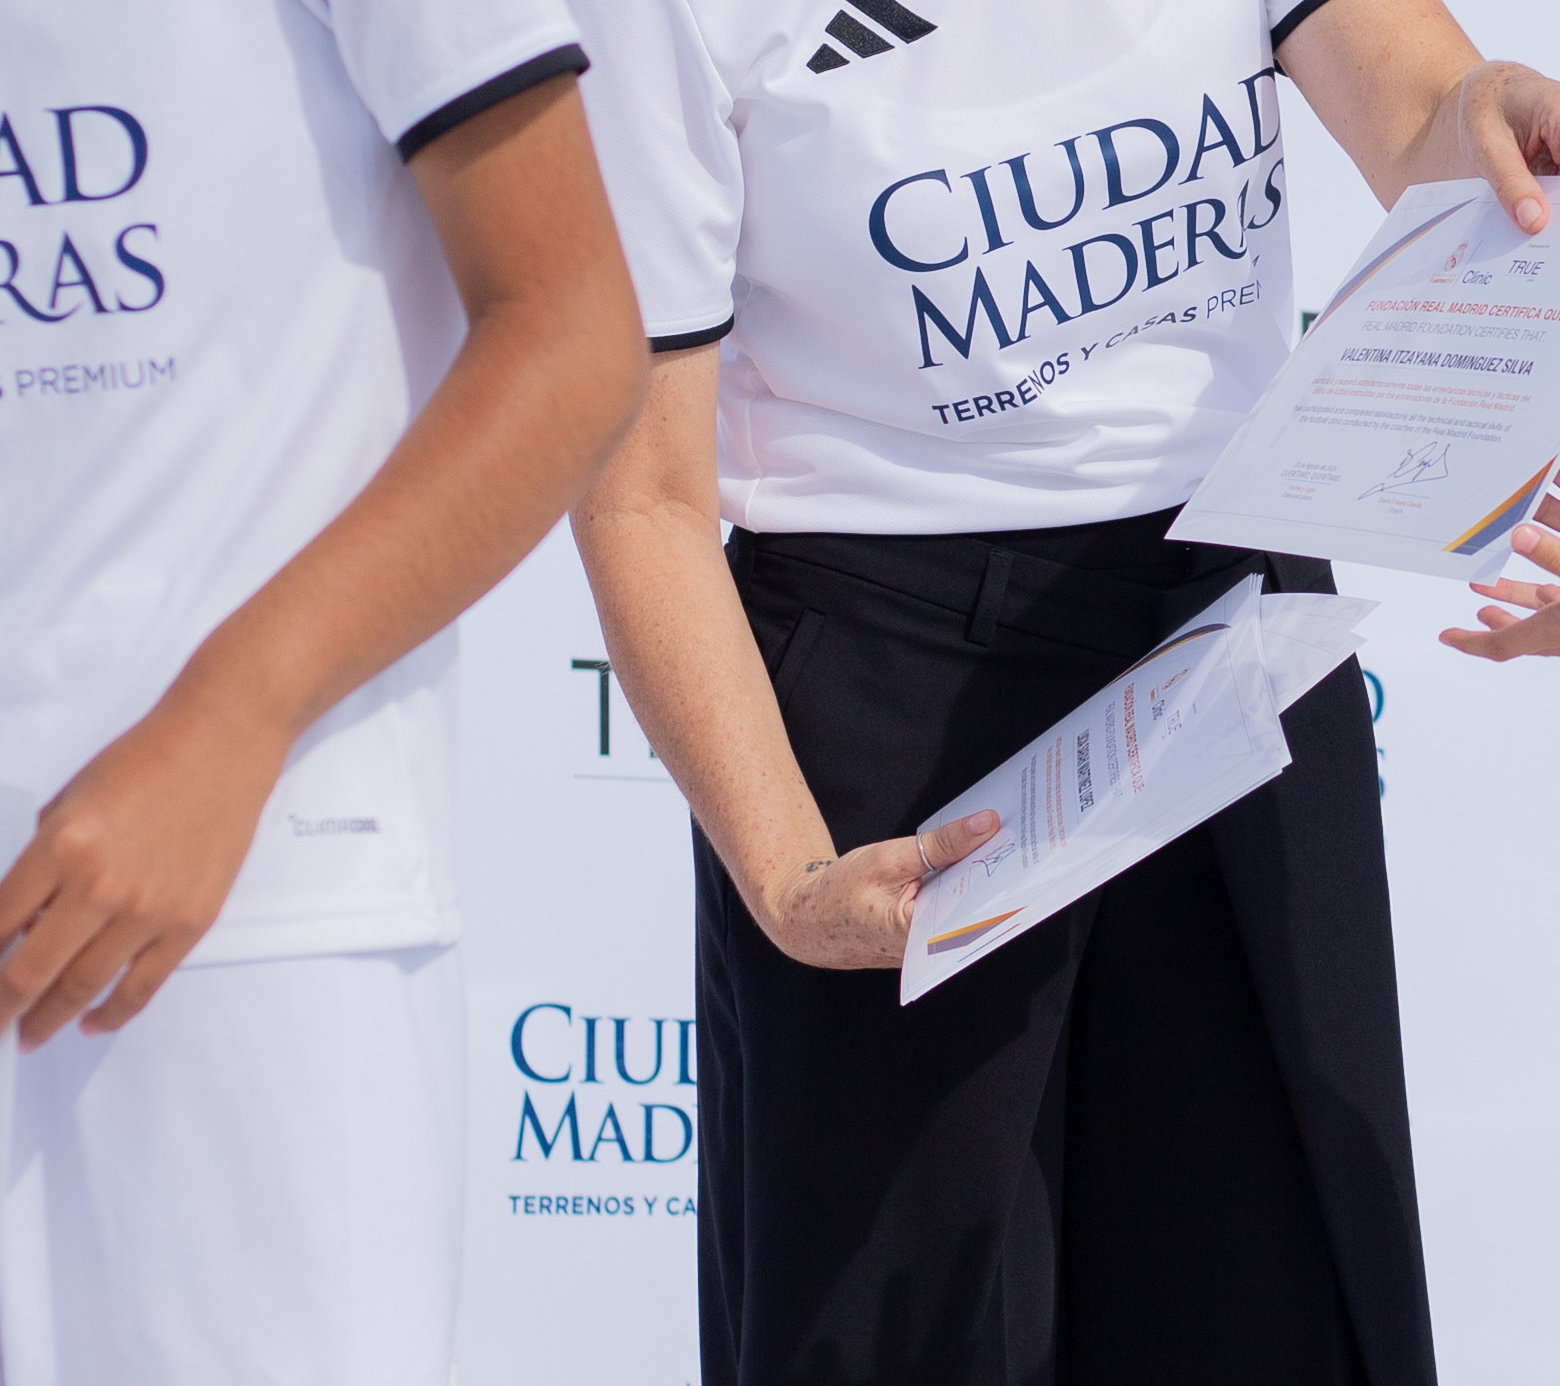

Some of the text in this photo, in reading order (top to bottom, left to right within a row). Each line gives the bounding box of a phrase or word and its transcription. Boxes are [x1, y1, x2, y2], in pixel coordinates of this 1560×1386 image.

[868, 66, 1281, 273] CIUDAD
[1462, 269, 1493, 285] Clinic
[1508, 260, 1544, 275] TRUE
[1421, 301, 1445, 313] REAL
[1447, 302, 1489, 316] MADRID
[1489, 305, 1541, 320] CERTIFICA
[932, 353, 1070, 424] TERRENOS
[1081, 343, 1099, 361] Y
[1106, 306, 1197, 349] CASAS
[1340, 347, 1392, 363] VALENTINA
[1440, 353, 1503, 372] DOMINGUEZ
[1501, 359, 1534, 376] SILVA
[15, 357, 177, 396] PREMIUM
[510, 1004, 697, 1086] CIU
[509, 1194, 634, 1217] TERRENOS
[645, 1196, 657, 1215] Y
